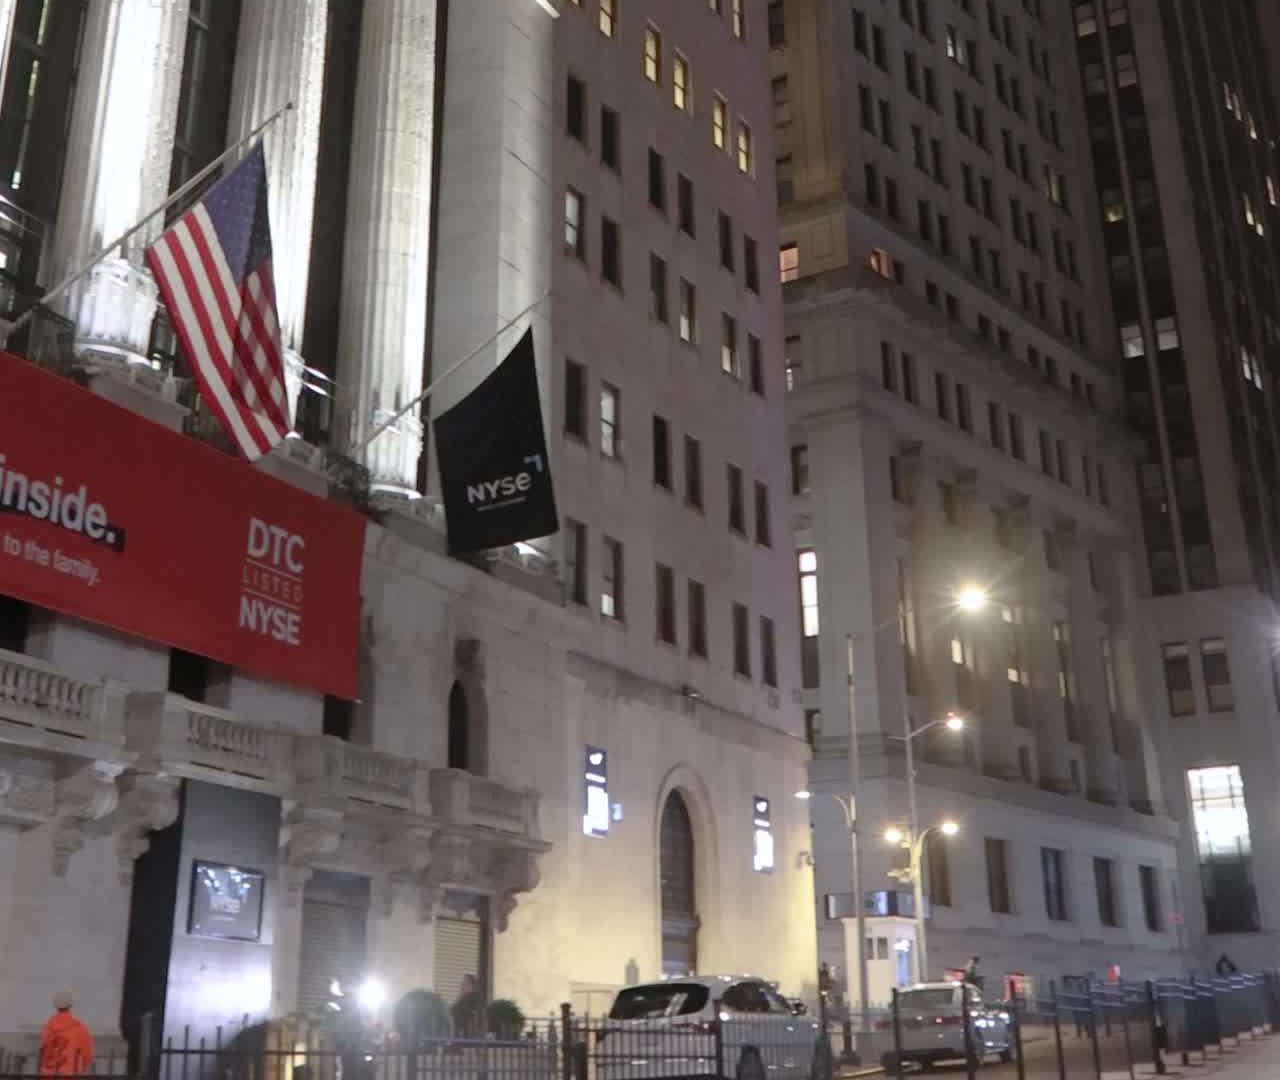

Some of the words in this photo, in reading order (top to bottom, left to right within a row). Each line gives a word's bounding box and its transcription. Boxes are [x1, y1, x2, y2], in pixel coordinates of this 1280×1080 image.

[3, 533, 22, 557] to
[24, 539, 50, 568] the
[247, 517, 305, 573] DTC
[241, 565, 304, 602] LISTED
[239, 595, 302, 646] NYSE
